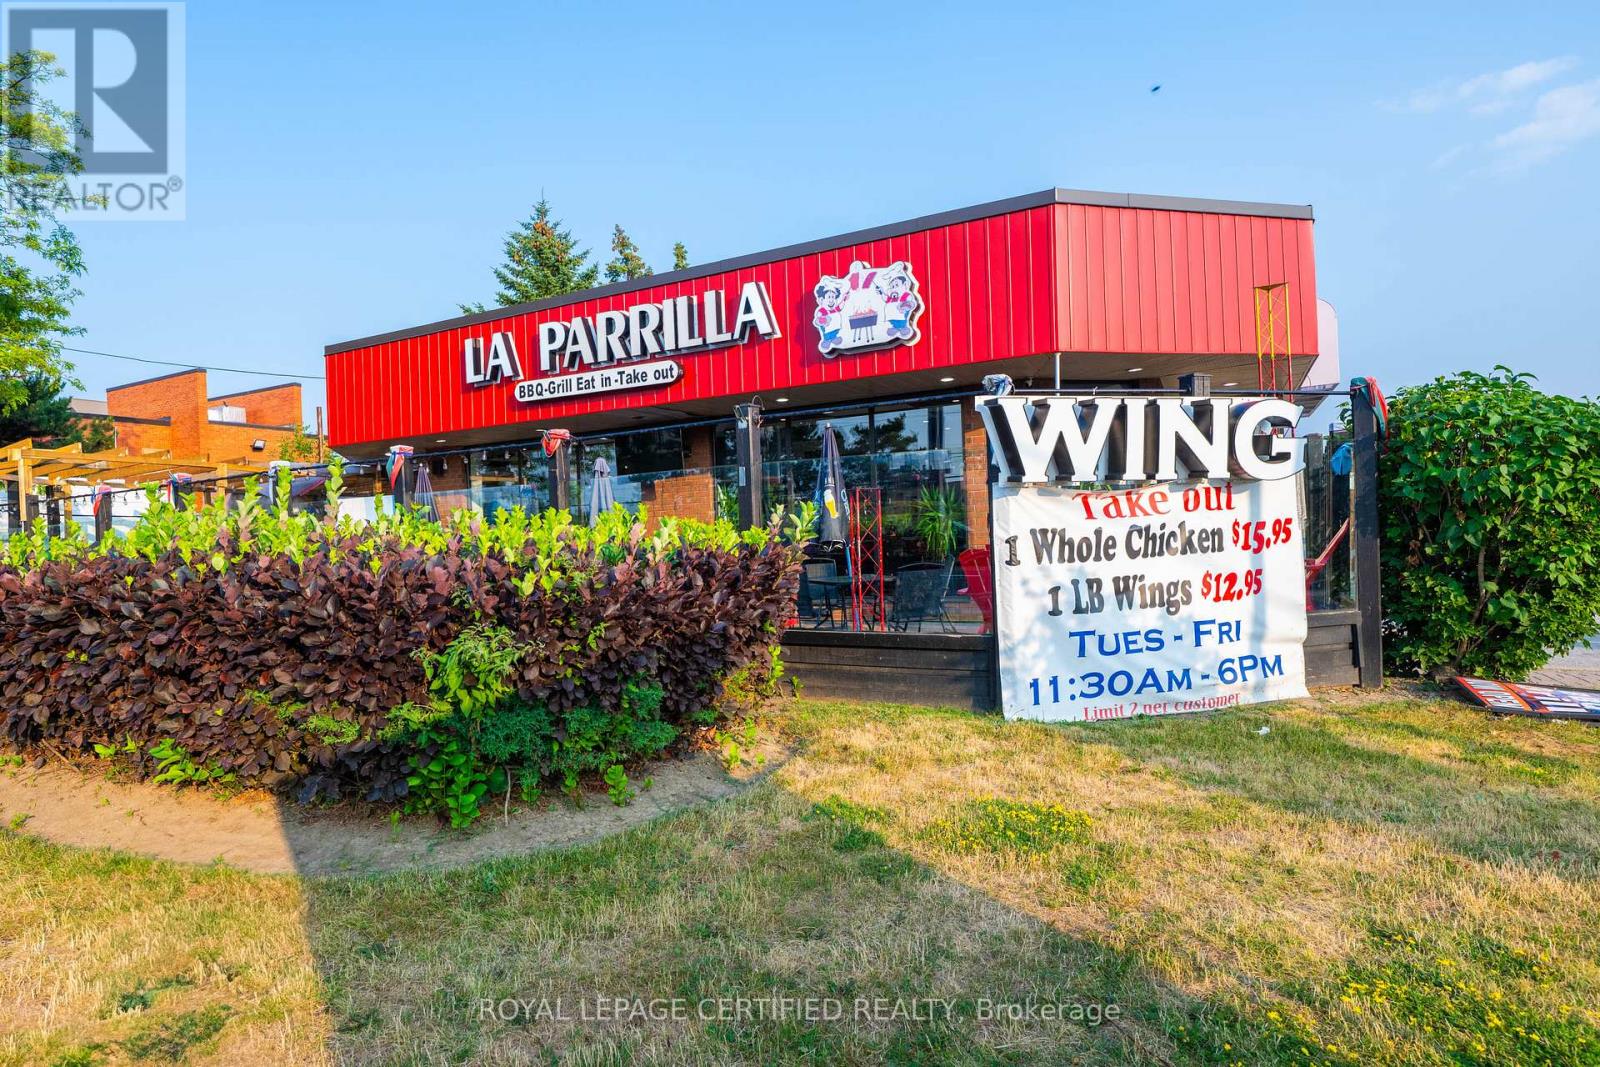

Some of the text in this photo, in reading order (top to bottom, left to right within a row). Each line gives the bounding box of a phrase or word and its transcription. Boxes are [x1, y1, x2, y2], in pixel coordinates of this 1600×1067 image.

[464, 281, 781, 387] LA PARRILLA
[518, 378, 573, 399] BBQ-Grill
[576, 375, 596, 391] Eat
[600, 373, 616, 388] in
[653, 364, 675, 380] out
[975, 396, 1307, 482] WING
[1072, 481, 1237, 520] Take out
[1005, 517, 1293, 566] 1 Whole Chicken $15.95
[1048, 568, 1264, 617] 1 LB Wings $12.95
[1082, 703, 1124, 722] Limit
[1174, 692, 1241, 713] customer
